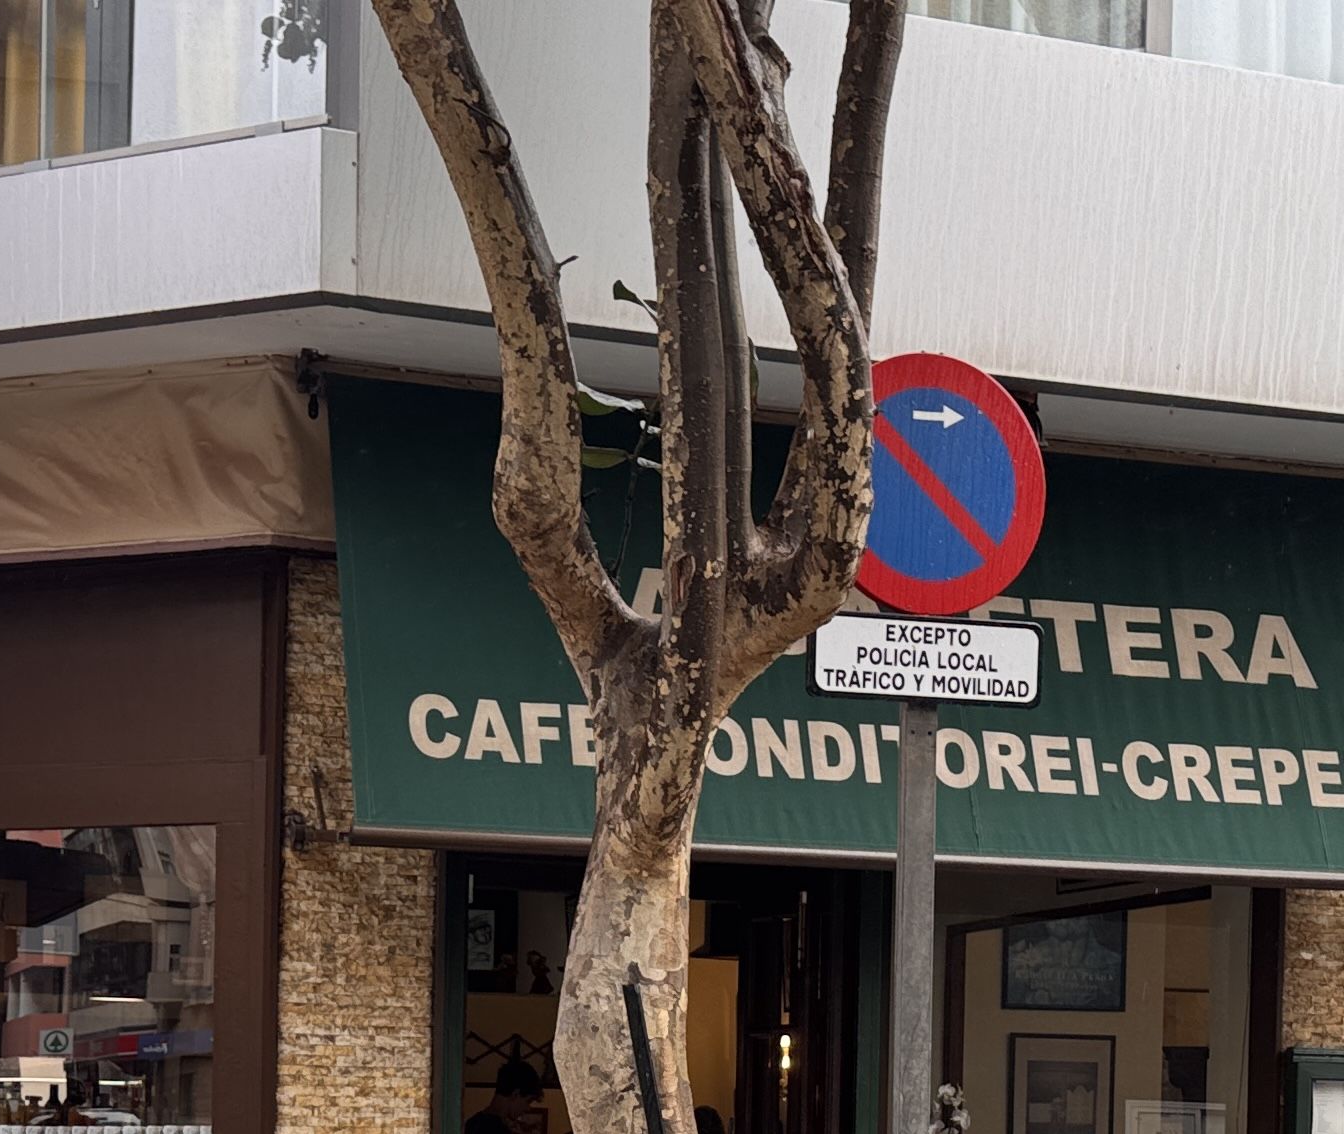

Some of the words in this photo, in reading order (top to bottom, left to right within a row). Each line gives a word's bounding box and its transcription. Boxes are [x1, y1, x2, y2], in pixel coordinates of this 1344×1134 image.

[885, 624, 972, 647] EXCEPTO
[937, 652, 999, 673] LOCAL
[912, 674, 925, 693] Y
[931, 676, 1030, 698] MOVILIDAD
